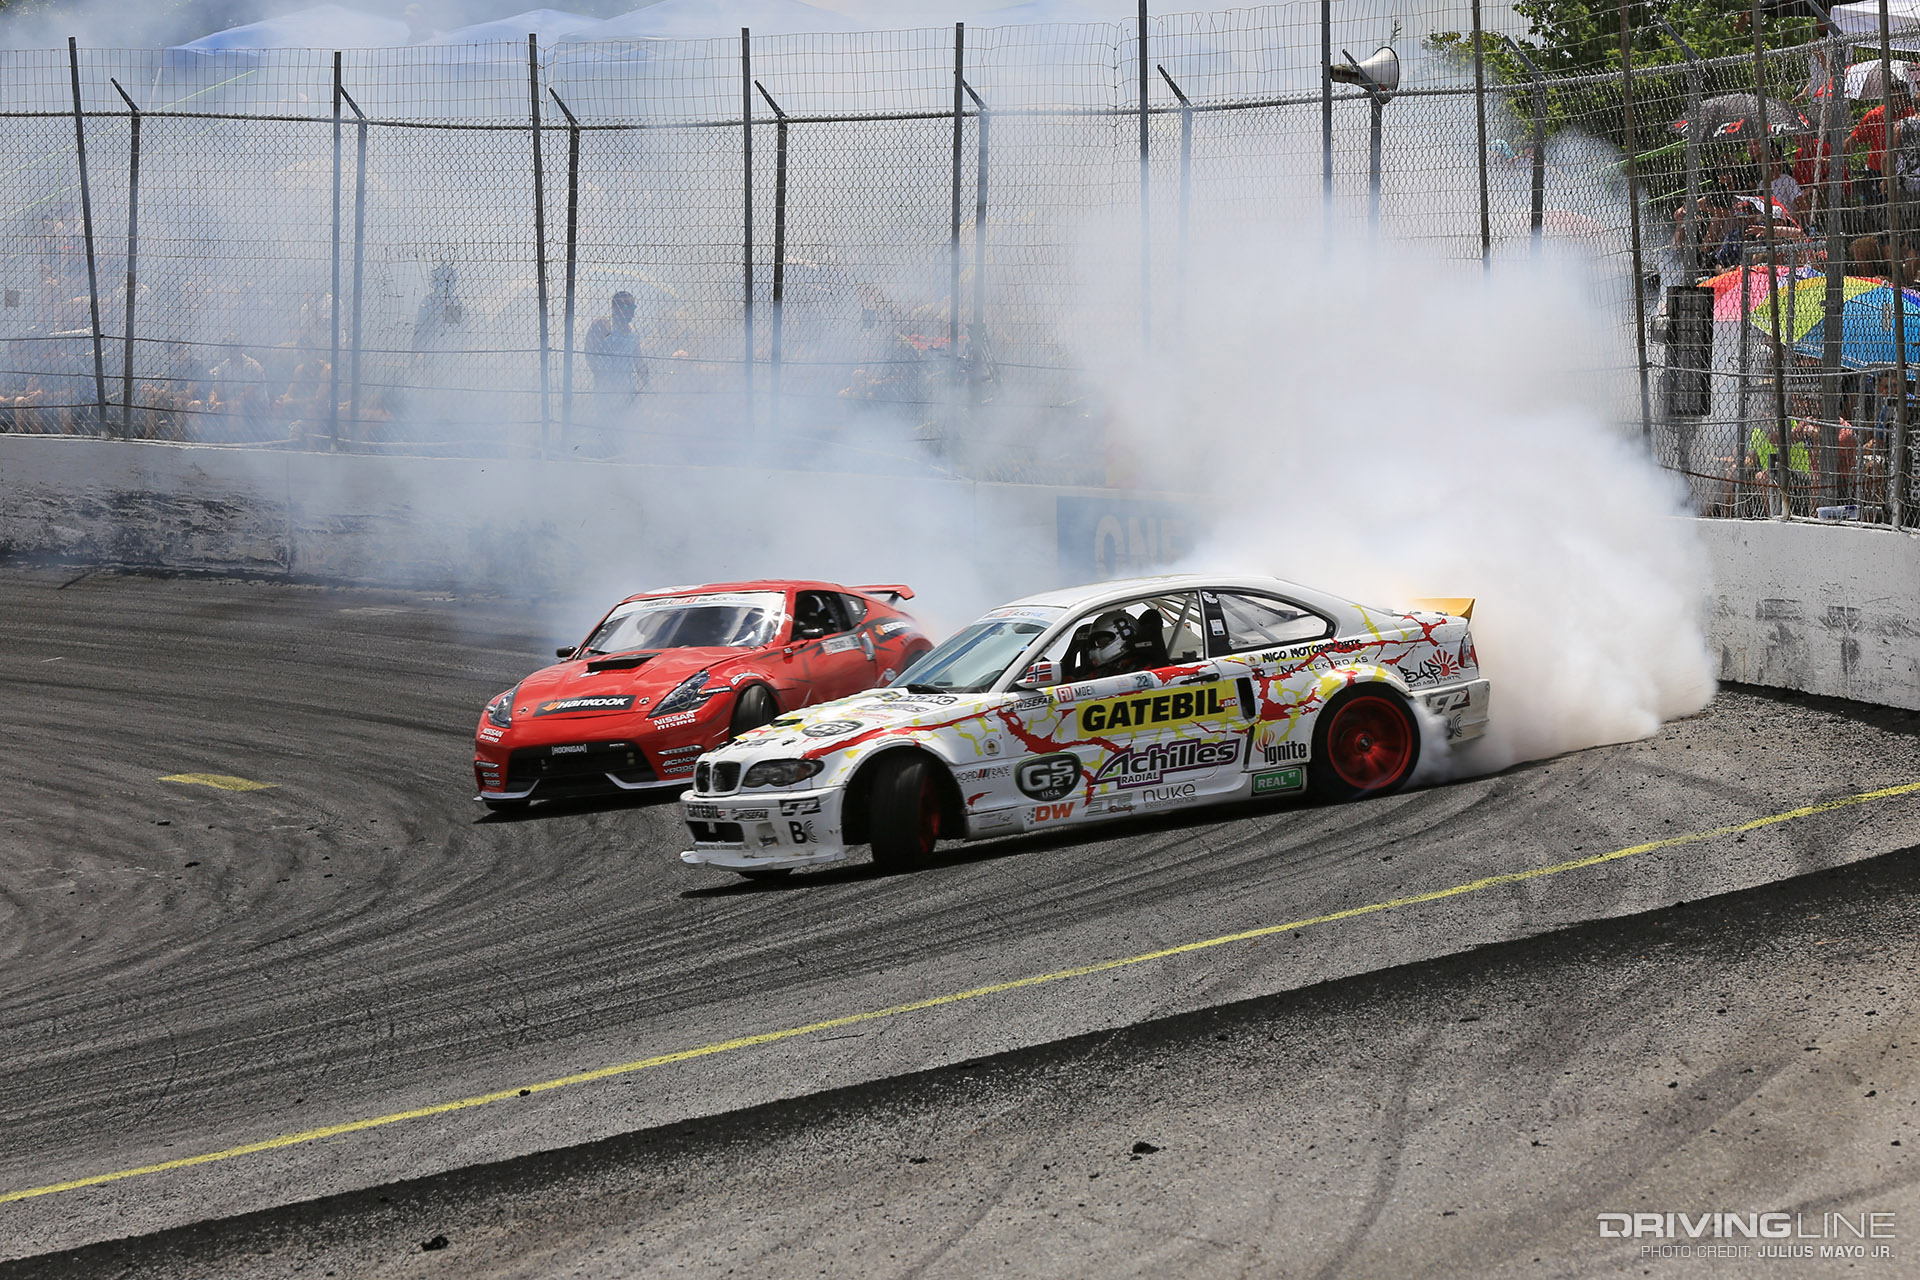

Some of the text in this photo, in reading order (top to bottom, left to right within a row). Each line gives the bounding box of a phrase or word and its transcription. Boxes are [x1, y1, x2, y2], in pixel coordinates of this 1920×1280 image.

[1094, 514, 1186, 578] ONE
[1290, 638, 1364, 658] MOTORSPORTS
[1354, 655, 1370, 664] AS
[1134, 675, 1150, 688] 22
[653, 712, 696, 727] NISSAN
[1081, 688, 1226, 733] GATEBIL
[482, 727, 505, 738] NISSAN
[1099, 742, 1235, 779] Achilles
[1263, 741, 1308, 766] ignite
[1120, 771, 1160, 785] RADIAL
[1257, 770, 1297, 789] REAL ST
[1041, 790, 1061, 799] USA
[1142, 783, 1196, 802] nuke
[1034, 801, 1076, 823] DW
